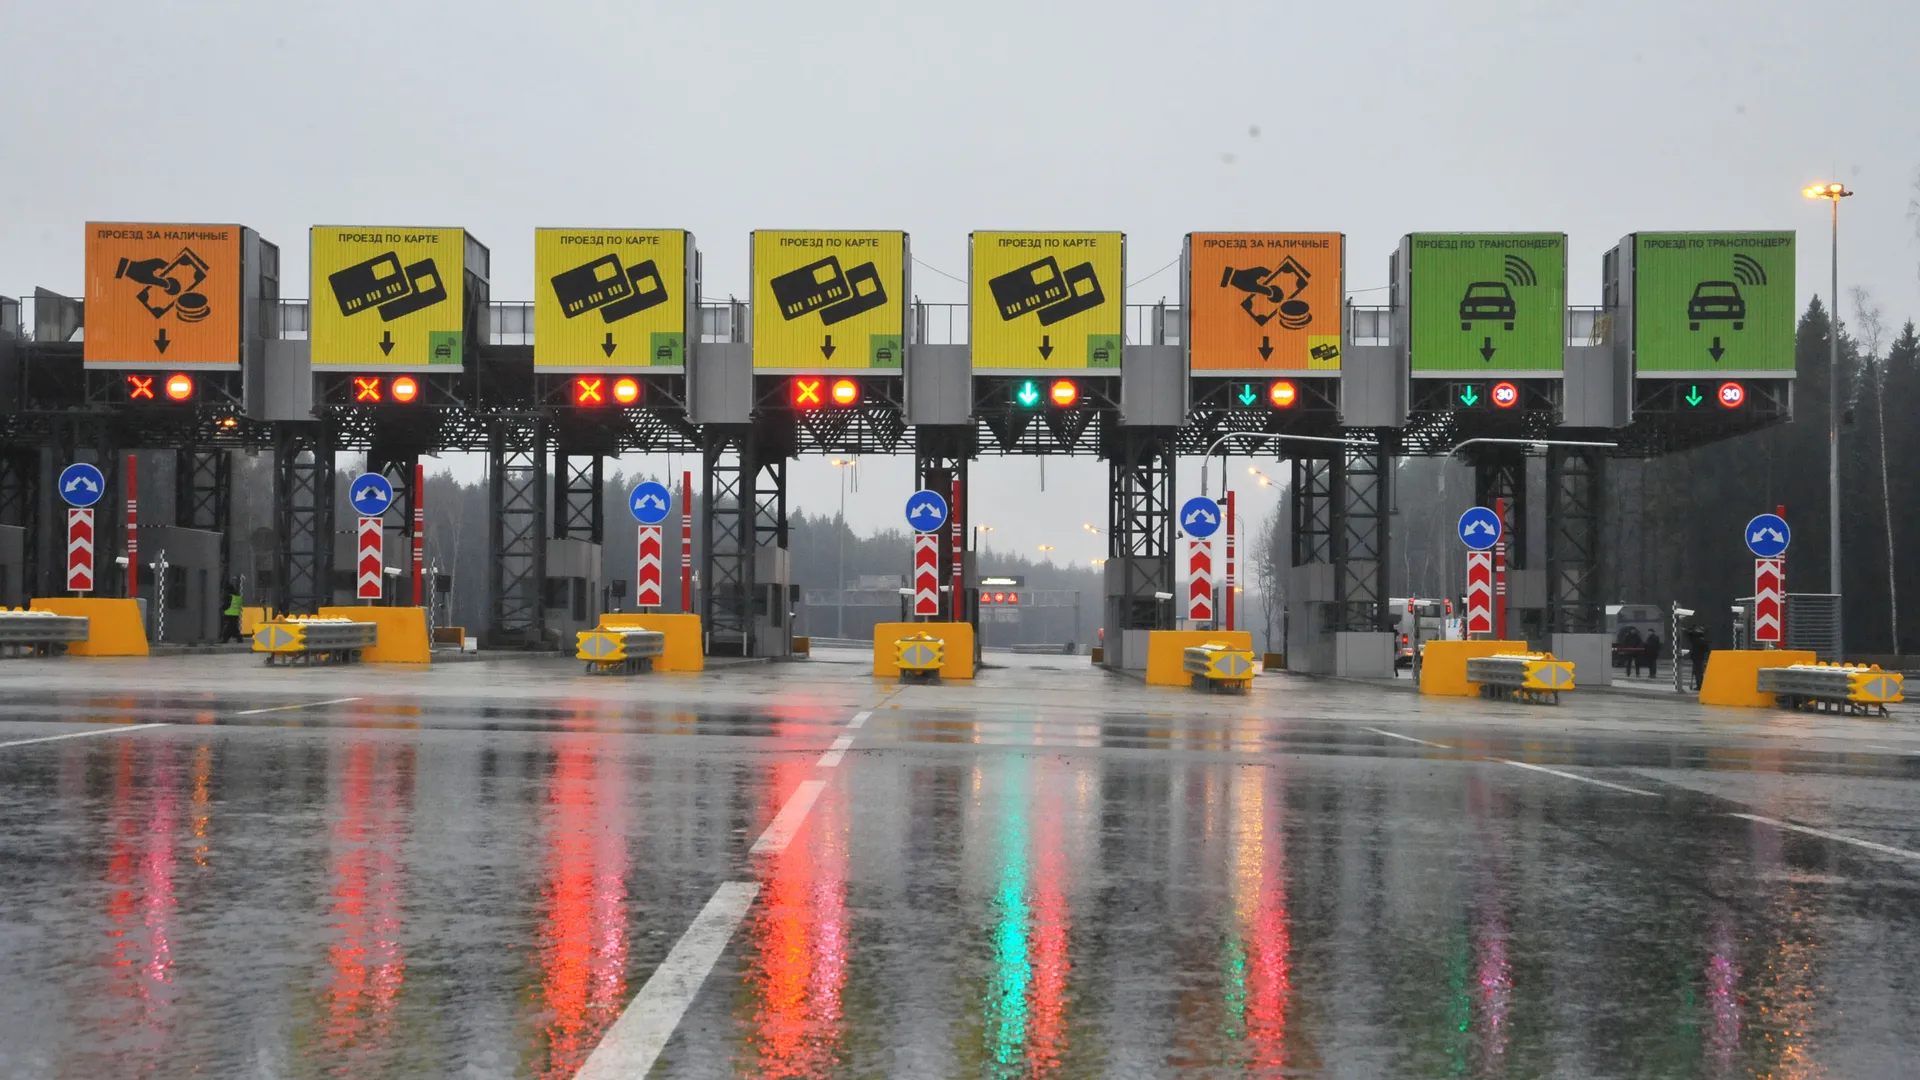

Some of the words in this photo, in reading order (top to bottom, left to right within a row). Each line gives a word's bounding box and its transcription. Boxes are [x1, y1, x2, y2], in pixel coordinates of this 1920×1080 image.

[98, 230, 143, 240] ПРОЕЗД
[146, 230, 161, 240] ЗА
[164, 231, 229, 241] НАЛИЧНЫЕ
[339, 234, 382, 244] ПРОЕЗД
[386, 234, 401, 243] ПО
[404, 235, 438, 244] КАРТЕ
[560, 236, 603, 246] ПРОЕЗД
[607, 236, 622, 245] ПО
[626, 236, 659, 245] КАРТЕ
[780, 238, 823, 248] ПРОЕЗД
[826, 238, 841, 247] ПО
[845, 238, 878, 247] КАРТЕ
[998, 239, 1041, 248] ПРОЕЗД
[1044, 239, 1060, 247] ПО
[1063, 239, 1096, 247] КАРТЕ
[1204, 239, 1247, 249] ПРОЕЗД
[1250, 239, 1264, 248] ЗА
[1267, 240, 1329, 248] НАЛИЧНЫЕ
[1416, 240, 1458, 250] ПРОЕЗД
[1460, 240, 1476, 249] ПО
[1478, 239, 1561, 249] ТРАНСПОНДЕРУ
[1643, 239, 1686, 249] ПРОЕЗД
[1689, 239, 1704, 249] ПО
[1707, 238, 1792, 249] ТРАНСПОНДЕРУ
[1496, 388, 1513, 400] 30
[1723, 388, 1740, 400] 30
